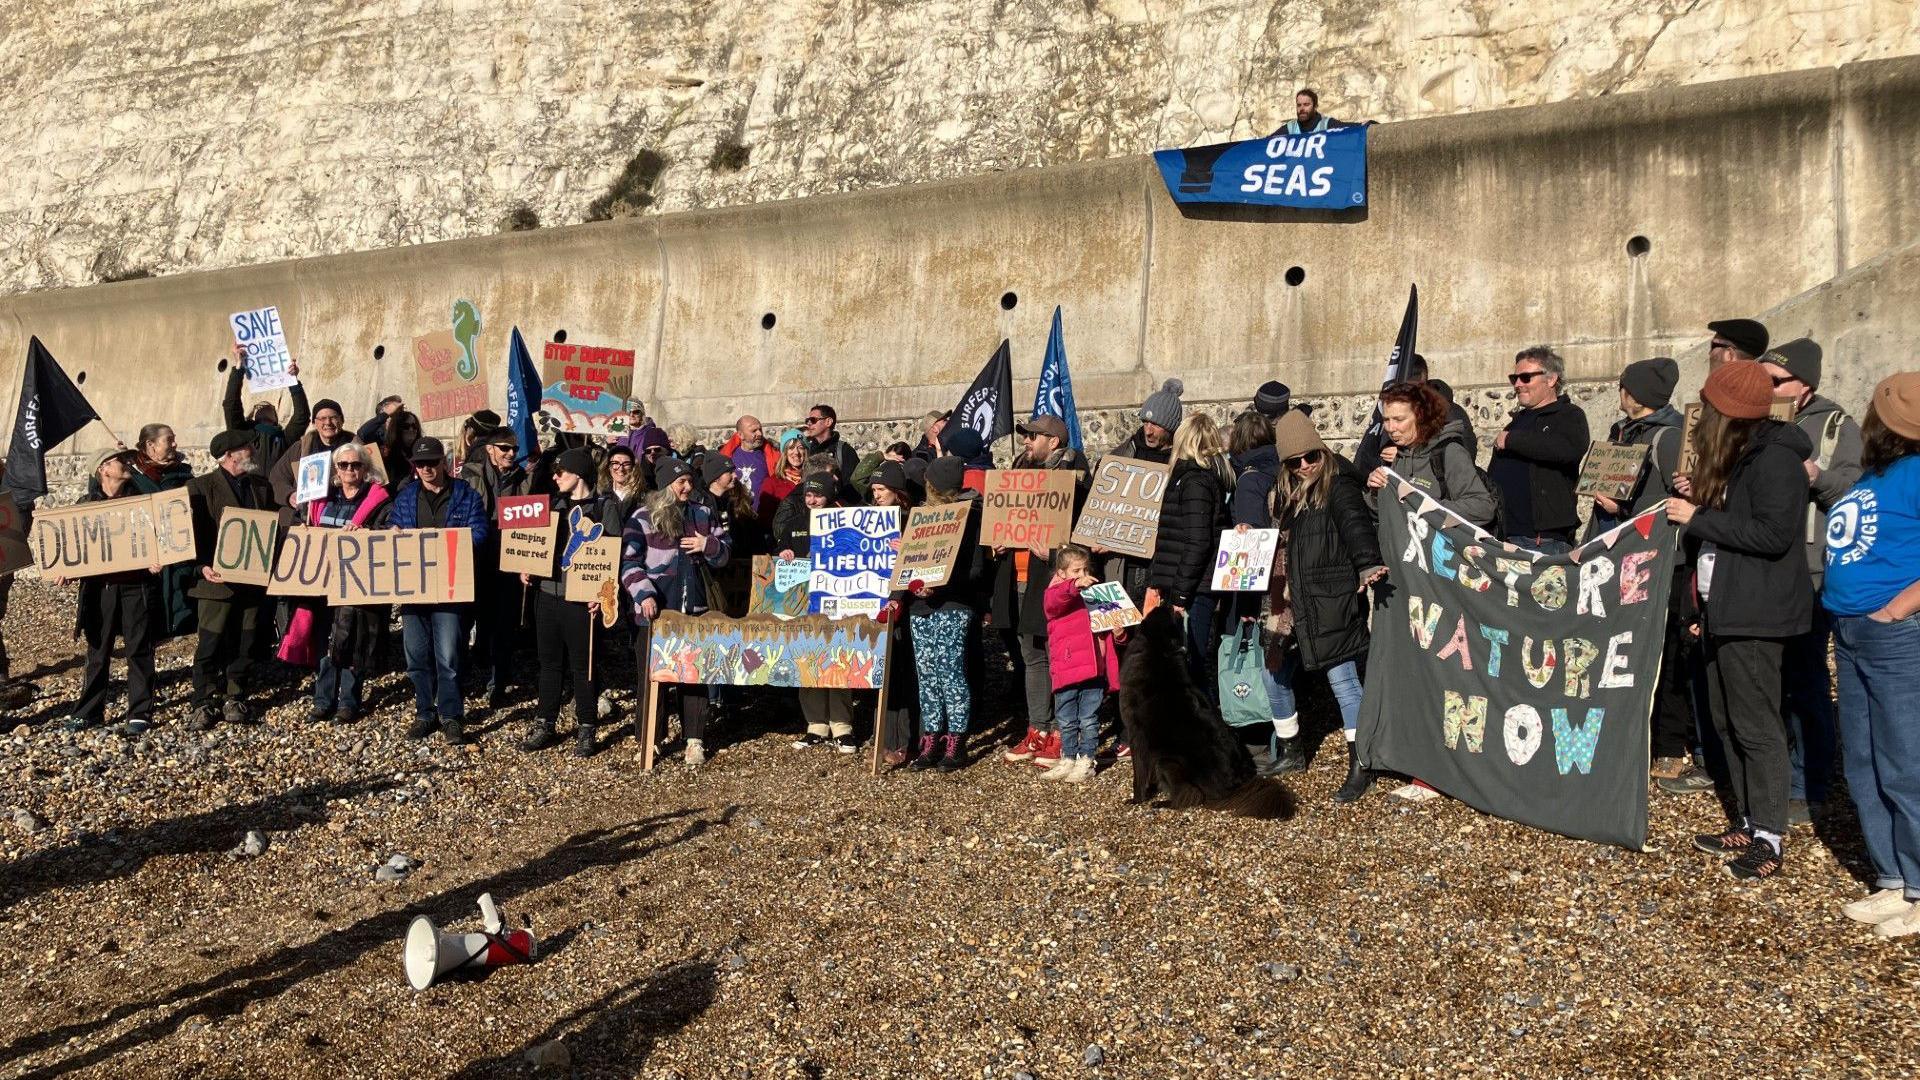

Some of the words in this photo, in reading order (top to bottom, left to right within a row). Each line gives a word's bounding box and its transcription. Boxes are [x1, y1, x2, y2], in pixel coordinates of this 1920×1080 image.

[1266, 134, 1327, 159] OUR
[1241, 164, 1334, 197] SEAS
[235, 308, 281, 341] SAVE
[247, 340, 277, 355] OUR
[544, 343, 576, 361] STOP
[580, 346, 635, 367] DUMPING
[245, 351, 288, 377] REEF
[564, 366, 580, 381] ON
[586, 368, 610, 382] OUR
[570, 384, 604, 401] REEF
[1037, 361, 1059, 415] AGAINS
[998, 471, 1048, 490] STOP
[987, 491, 1071, 512] POLLUTION
[503, 502, 544, 521] STOP
[911, 511, 940, 527] Don't
[943, 509, 955, 521] be
[1008, 508, 1040, 522] FOR
[816, 510, 846, 530] THE
[852, 509, 896, 535] OCEAN
[1082, 515, 1101, 528] ON
[38, 499, 192, 570] DUMPING
[511, 531, 547, 545] dumping
[992, 522, 1057, 544] PROFIT
[1230, 531, 1270, 550] STOP
[1841, 513, 1879, 566] SEWAGE
[217, 517, 277, 573] ON
[506, 547, 516, 555] on
[532, 551, 548, 559] reef
[585, 547, 598, 556] It's
[821, 535, 835, 549] IS
[860, 538, 892, 553] OUR
[338, 530, 458, 600] REEF!
[573, 562, 612, 572] protected
[815, 553, 897, 571] LIFELINE
[1218, 550, 1271, 568] DUMPING
[1402, 510, 1658, 617] RESTORE
[581, 573, 602, 581] area!
[1222, 575, 1257, 590] REEF
[1081, 583, 1125, 603] SAVE
[840, 600, 877, 609] Sussex
[1408, 595, 1635, 699] NATURE
[1443, 690, 1606, 775] NOW
